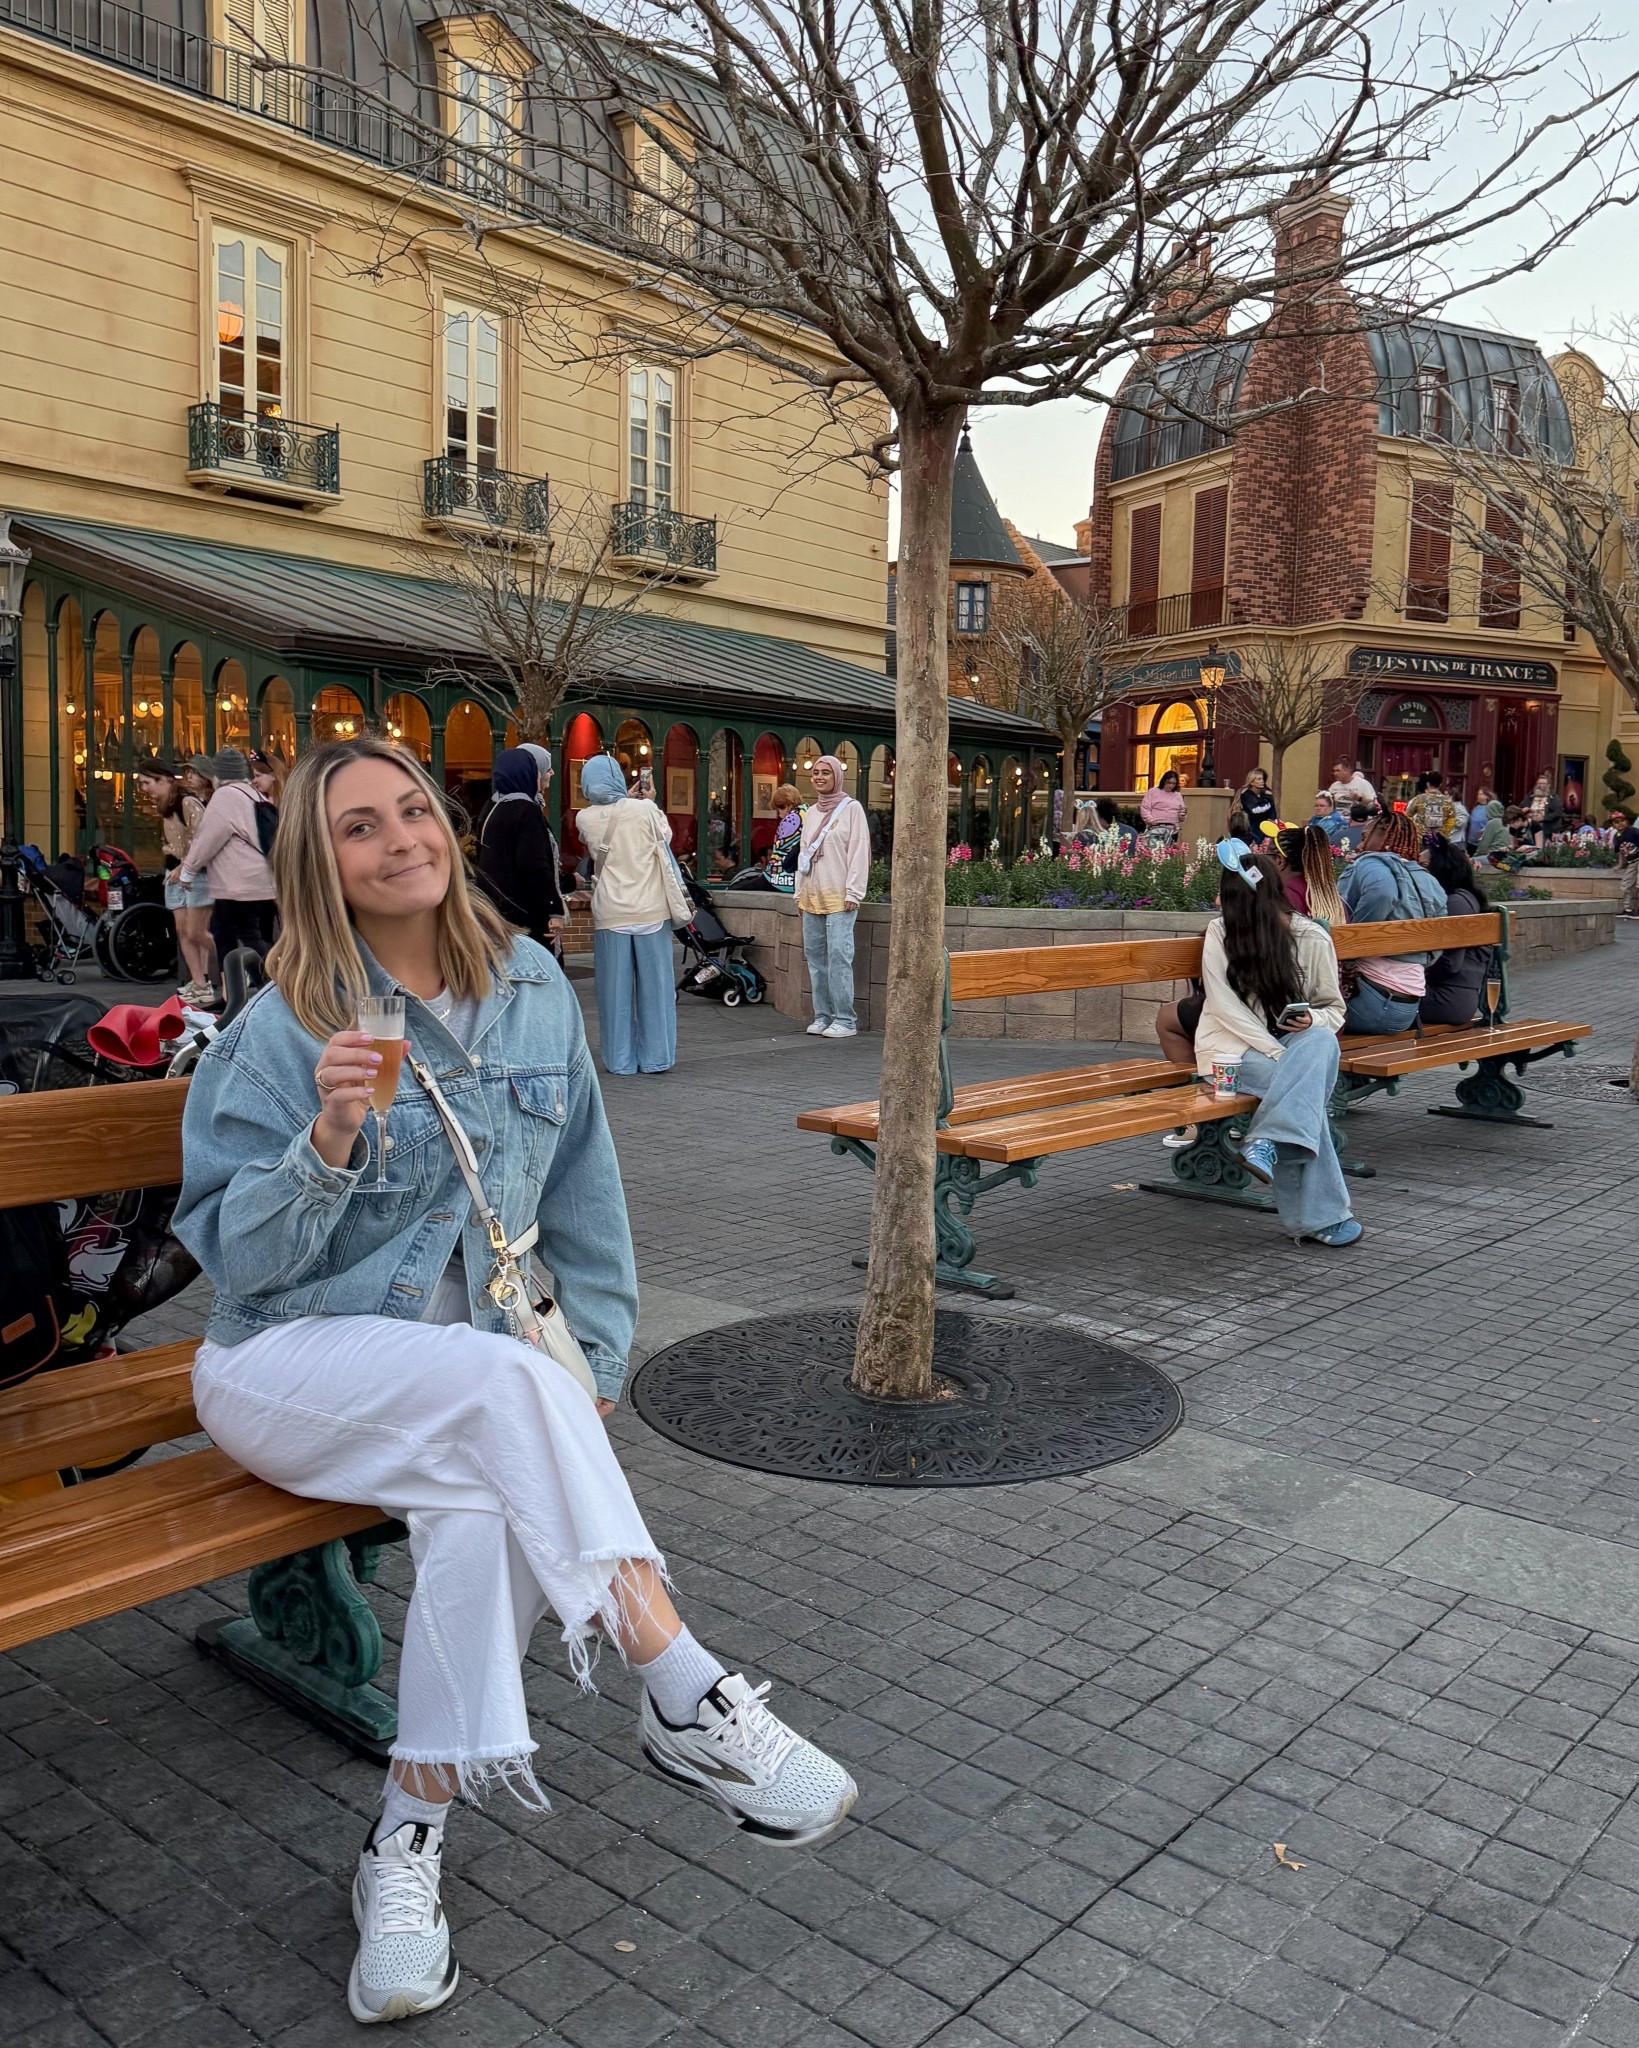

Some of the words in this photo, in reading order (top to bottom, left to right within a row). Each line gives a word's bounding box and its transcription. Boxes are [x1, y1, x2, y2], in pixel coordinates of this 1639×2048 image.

[1181, 664, 1193, 678] du
[1376, 655, 1407, 670] LES
[1411, 658, 1449, 674] VINS
[1452, 661, 1467, 671] DE
[1470, 662, 1533, 680] FRANCE
[1399, 702, 1413, 712] LES
[1413, 701, 1428, 713] VINS
